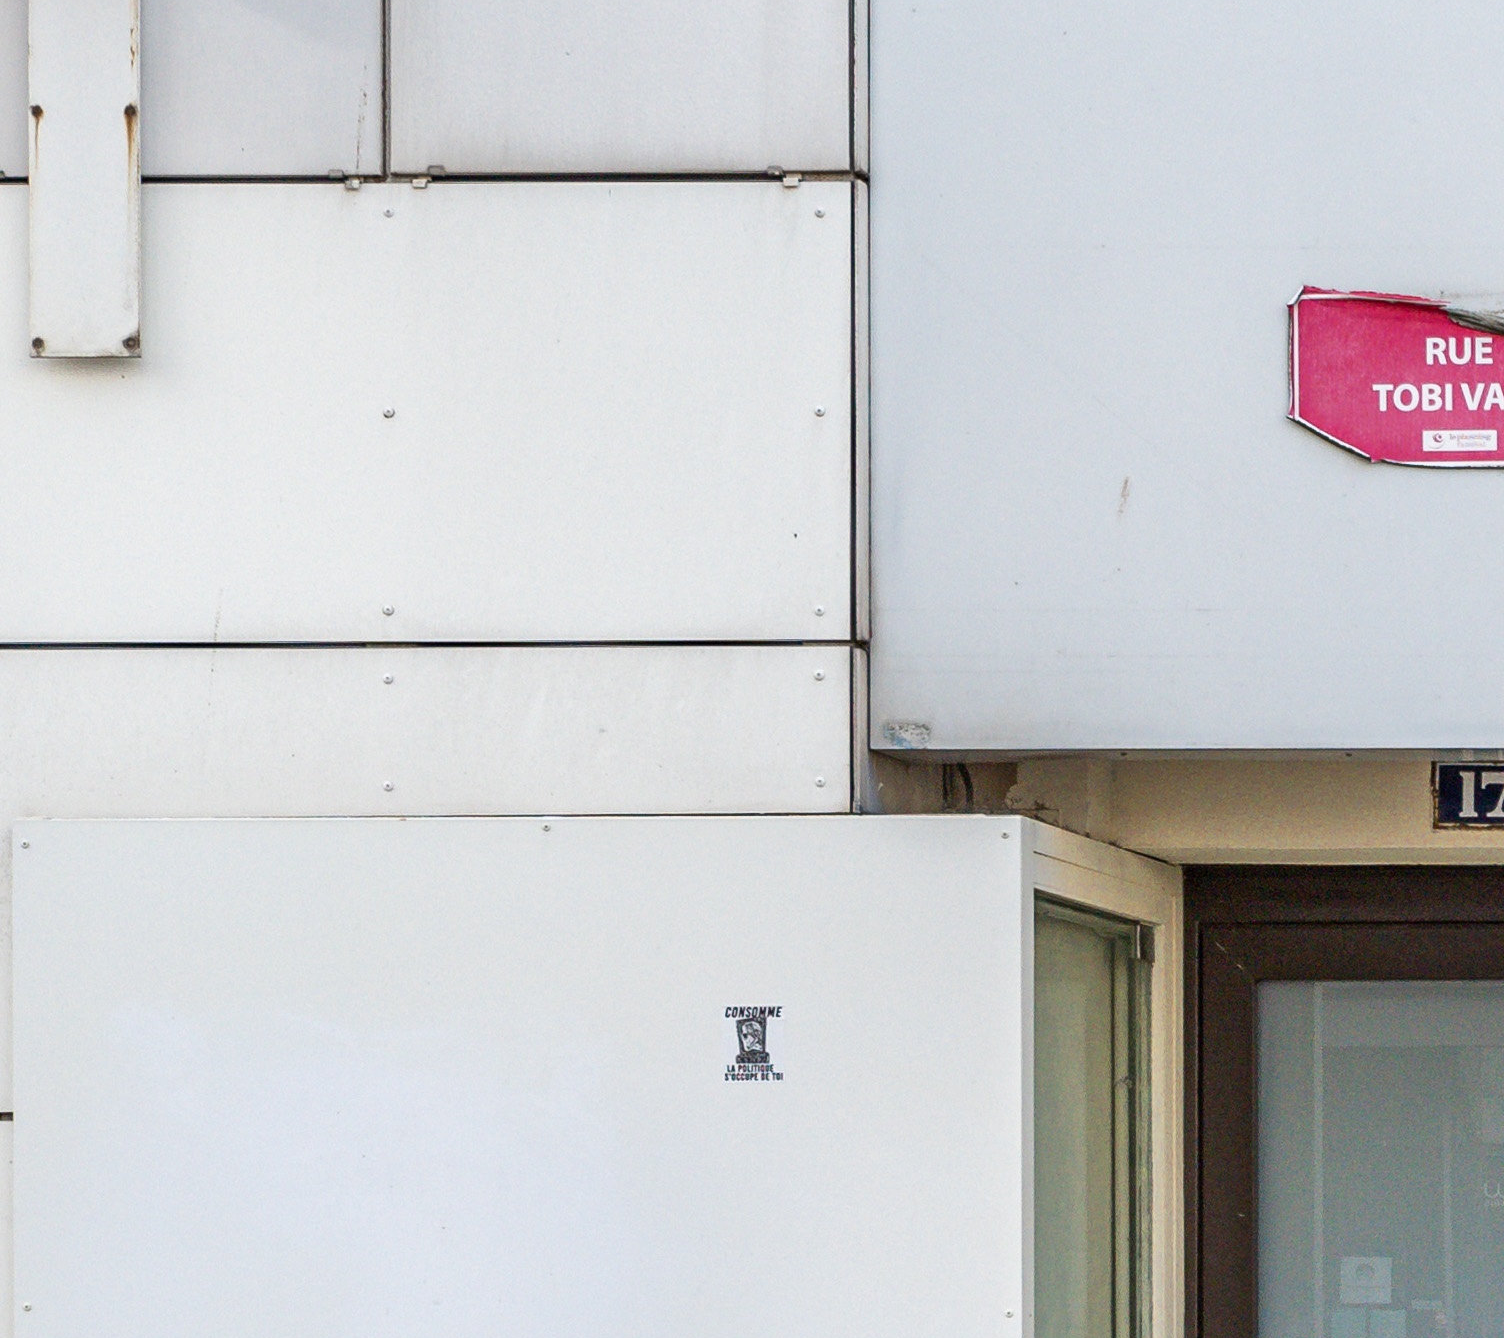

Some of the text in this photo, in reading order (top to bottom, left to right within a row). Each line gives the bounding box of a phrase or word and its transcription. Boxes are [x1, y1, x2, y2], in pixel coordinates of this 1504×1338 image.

[1425, 336, 1494, 366] RUE
[1372, 383, 1453, 412] TOBI
[724, 1006, 783, 1018] CONSOMME
